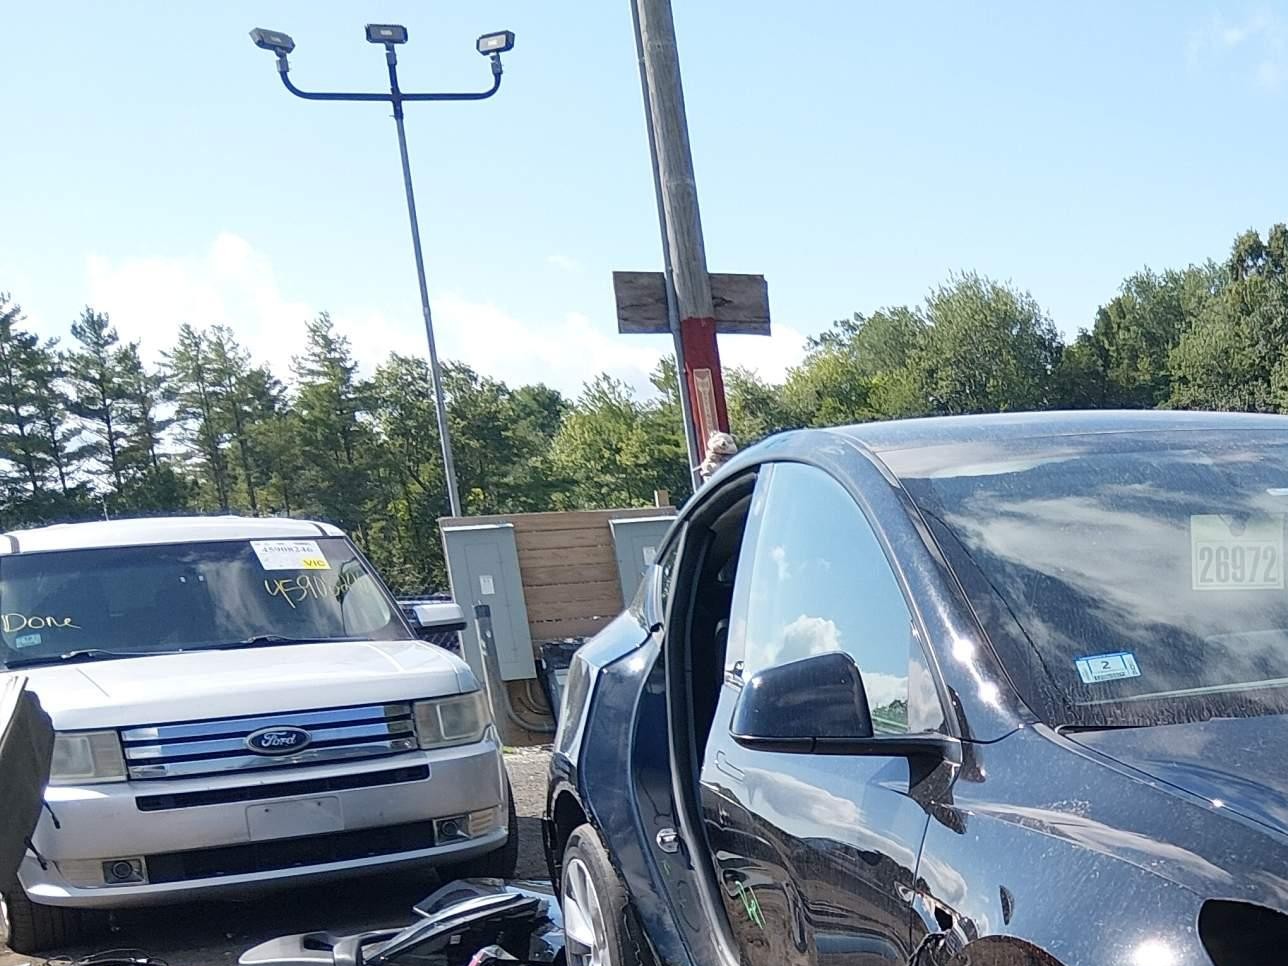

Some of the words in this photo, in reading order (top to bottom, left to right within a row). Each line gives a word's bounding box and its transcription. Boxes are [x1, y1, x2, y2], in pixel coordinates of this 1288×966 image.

[1199, 546, 1277, 583] 26972
[1, 613, 81, 632] Done
[1101, 661, 1111, 670] 2
[261, 731, 297, 747] Ford
